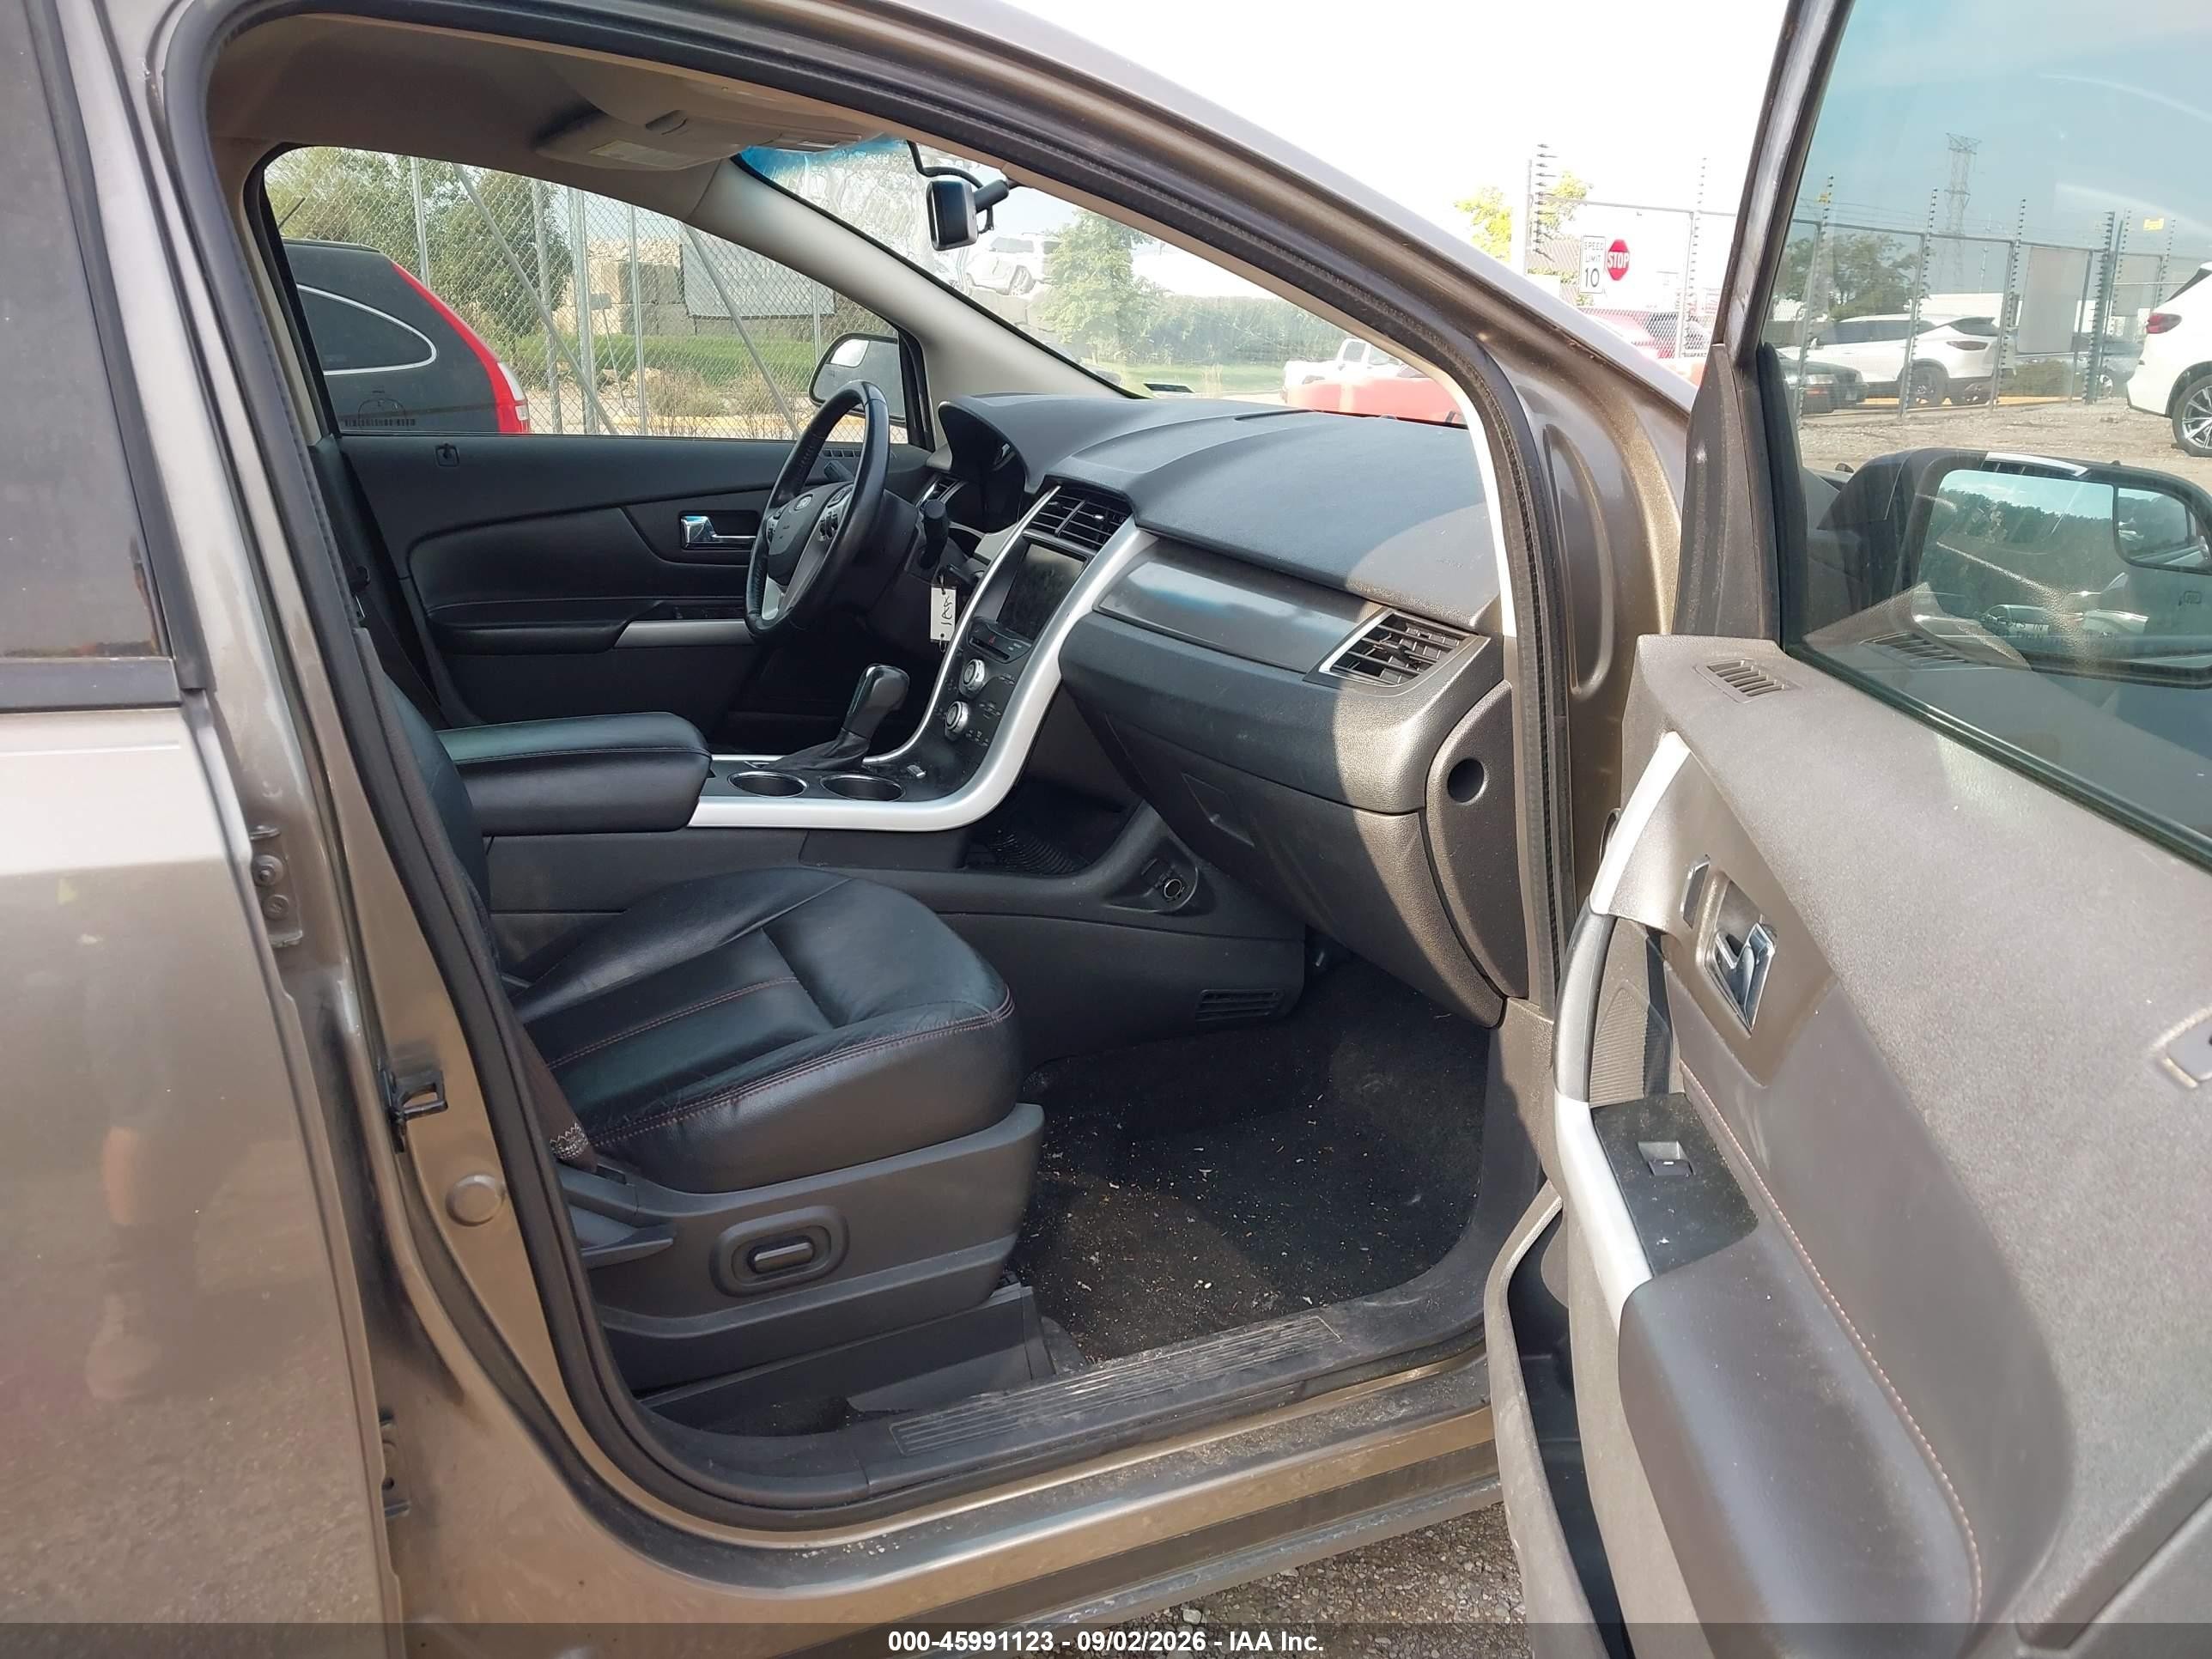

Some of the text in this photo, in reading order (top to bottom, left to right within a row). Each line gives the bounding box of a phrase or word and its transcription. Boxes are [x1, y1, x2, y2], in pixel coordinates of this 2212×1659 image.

[1584, 241, 1604, 250] SPEED
[1607, 252, 1629, 268] STOP
[1585, 267, 1600, 288] 10
